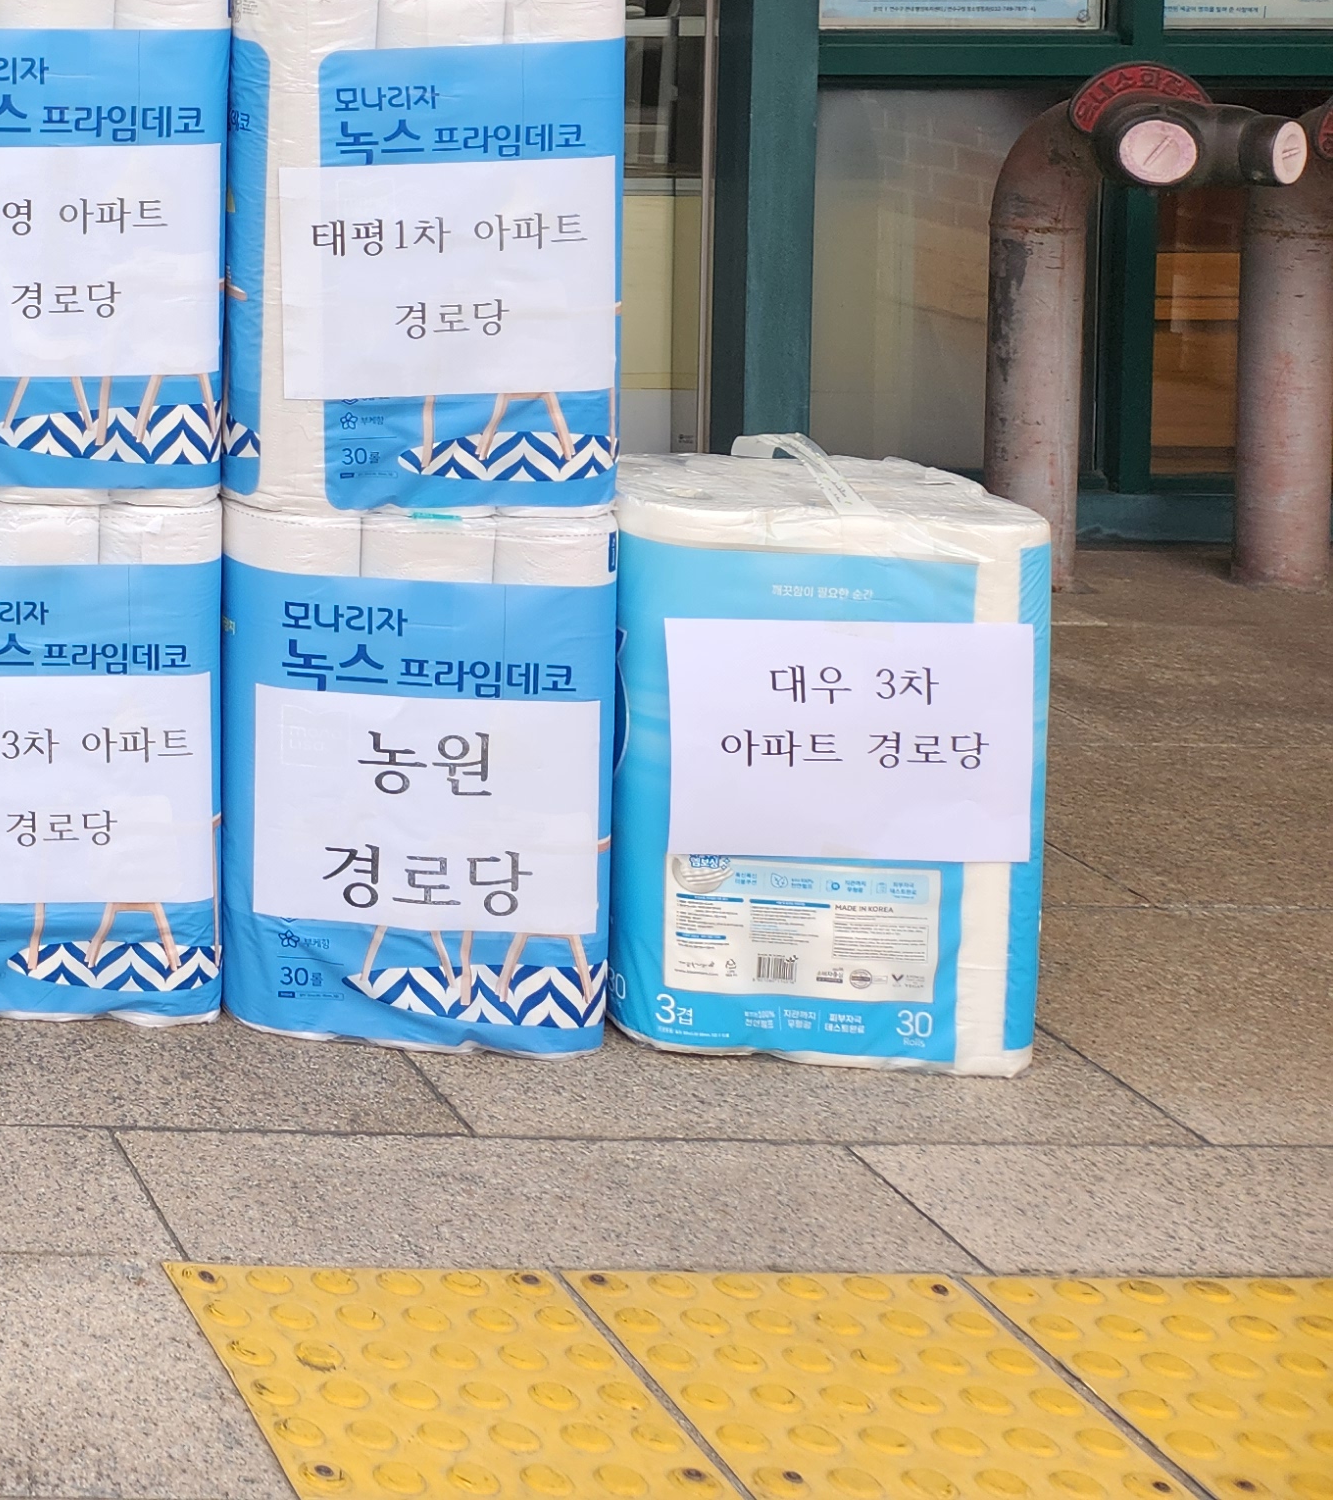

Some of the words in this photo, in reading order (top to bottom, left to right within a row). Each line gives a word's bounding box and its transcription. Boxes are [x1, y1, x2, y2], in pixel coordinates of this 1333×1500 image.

[58, 196, 169, 236] 아파트
[311, 217, 452, 259] 태평1차
[473, 212, 590, 251] 아파트
[10, 280, 122, 319] 경로당
[394, 299, 510, 340] 경로당
[282, 601, 409, 638] 모나리자
[281, 639, 389, 693] 녹스
[395, 659, 578, 699] 프라임데코
[769, 663, 853, 706] 대우
[876, 666, 941, 706] 3차
[1, 728, 59, 766] 3차
[81, 725, 195, 765] 아파트
[357, 731, 493, 798] 농원
[720, 730, 843, 769] 아파트
[868, 730, 990, 770] 경로당
[5, 810, 118, 846] 경로당
[322, 845, 533, 918] 경로당
[835, 904, 856, 912] MADE
[654, 993, 694, 1025] 3겹
[895, 1010, 933, 1038] 30
